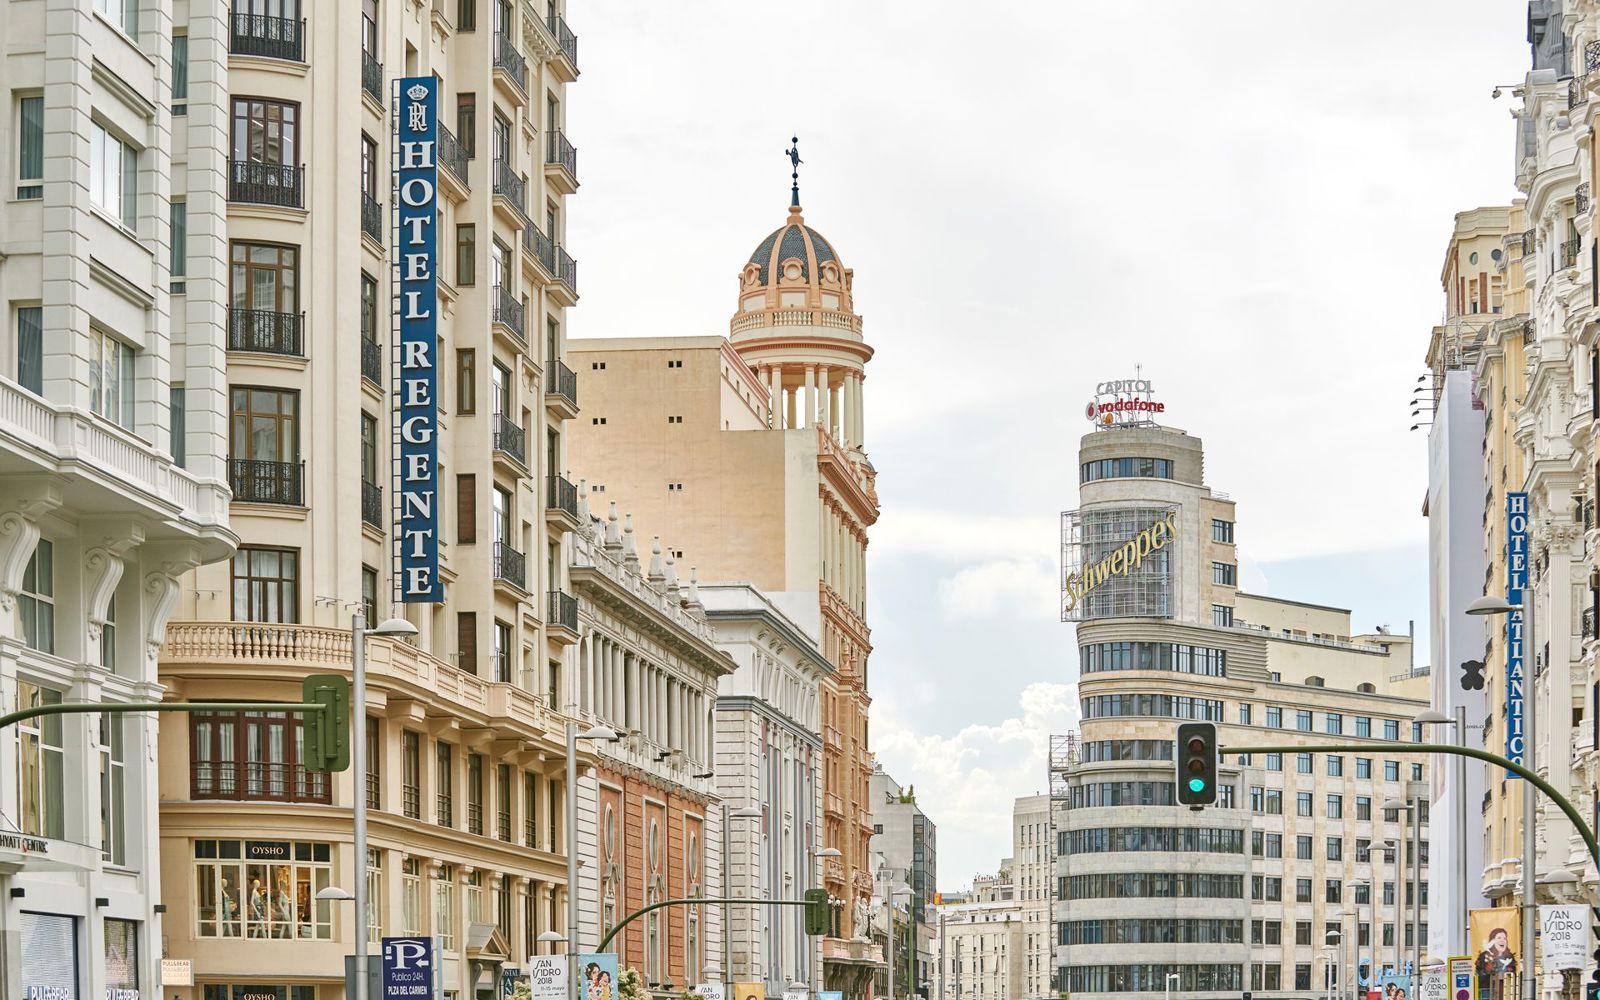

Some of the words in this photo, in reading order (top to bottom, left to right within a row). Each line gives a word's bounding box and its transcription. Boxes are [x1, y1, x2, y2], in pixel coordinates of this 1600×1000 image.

[400, 140, 434, 319] HOTEL
[1096, 379, 1155, 395] CAPITOL
[1097, 397, 1165, 413] vodafone
[401, 341, 434, 595] REGENTE
[1510, 496, 1526, 590] HOTEL
[1066, 511, 1177, 613] Schweppes
[0, 834, 21, 849] HYATT
[22, 838, 48, 853] CENTRIC
[252, 846, 284, 855] OYSHO
[1546, 910, 1570, 922] SAN
[1544, 920, 1583, 934] ISIDRO
[1550, 931, 1571, 941] 2018
[534, 959, 552, 970] SAN
[532, 968, 562, 979] ISIDRO
[387, 985, 399, 995] PLZA
[400, 985, 408, 995] DEL
[408, 985, 428, 995] CARMEN
